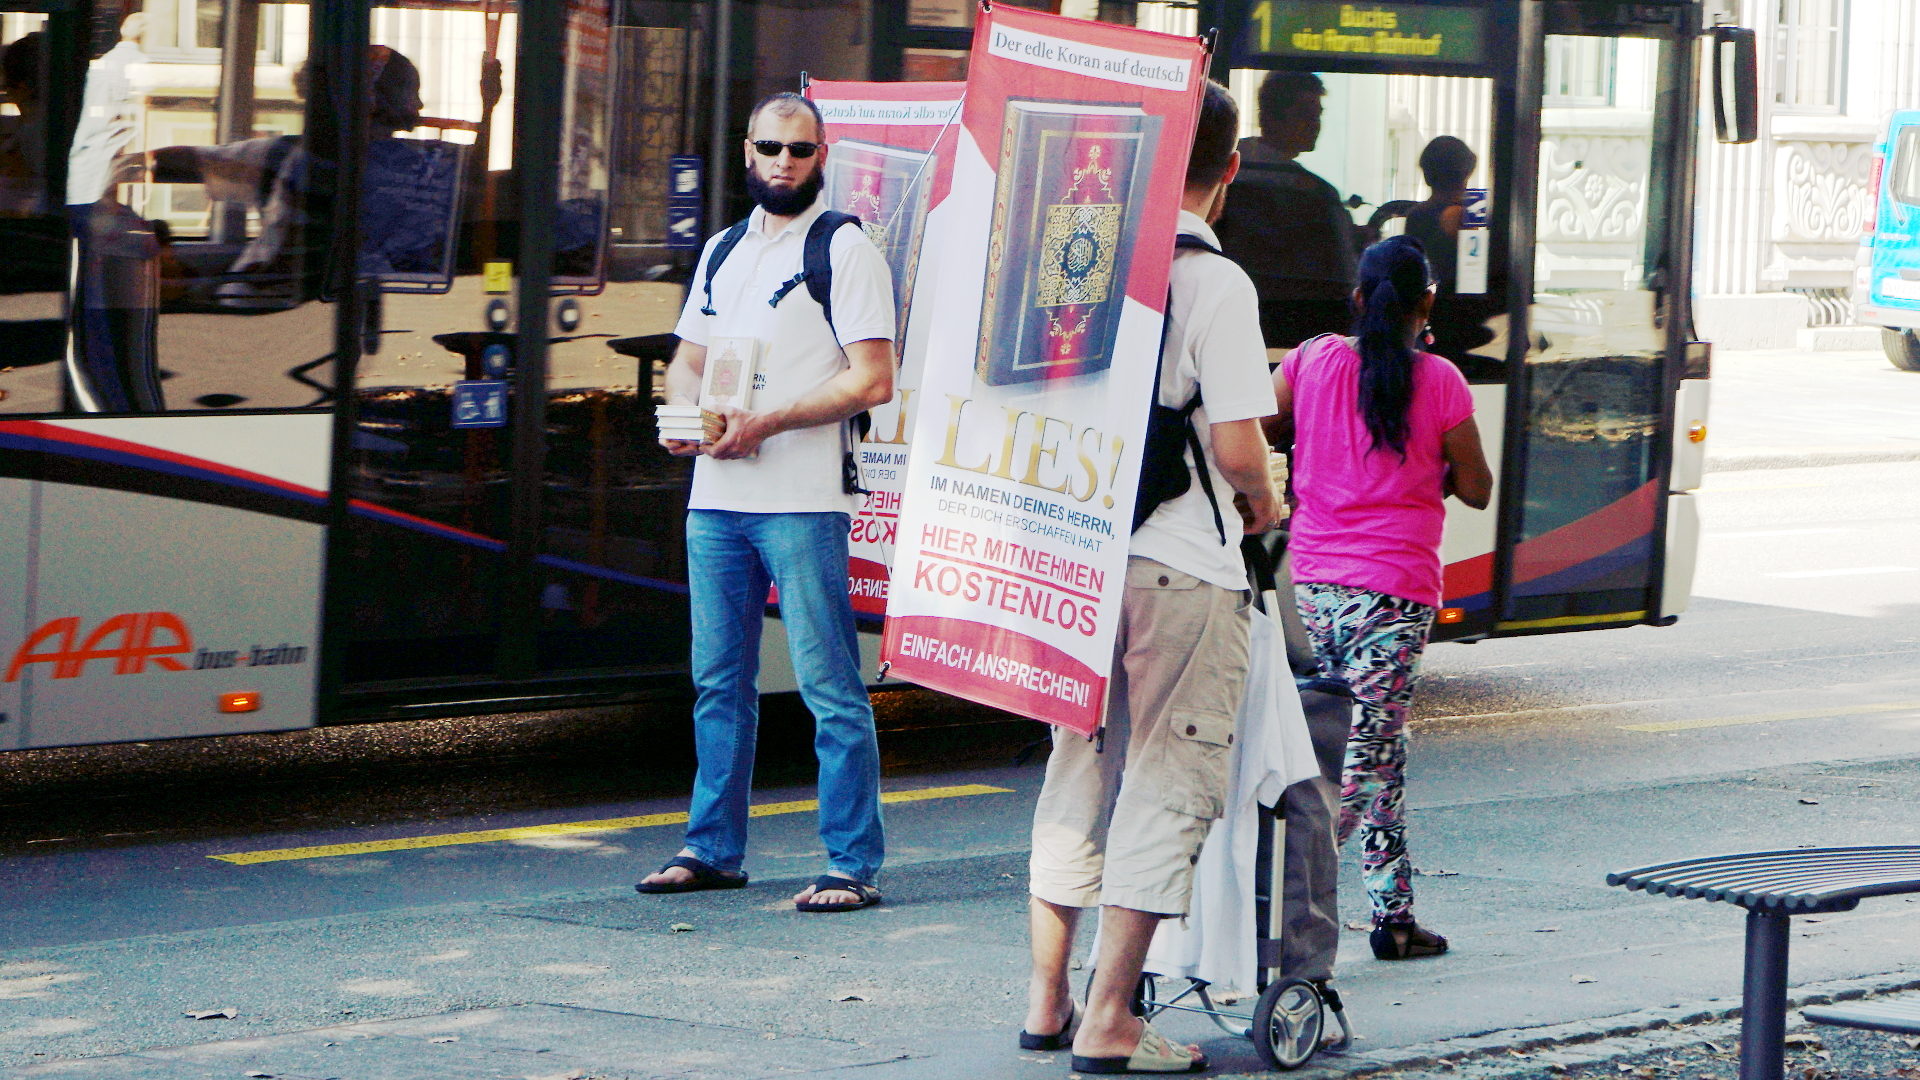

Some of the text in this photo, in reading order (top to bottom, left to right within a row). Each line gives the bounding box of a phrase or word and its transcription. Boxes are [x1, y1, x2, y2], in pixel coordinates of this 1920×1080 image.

[1252, 1, 1272, 51] 1
[1340, 4, 1397, 29] Buchs
[995, 32, 1184, 83] Der edle Koran auf deutsch
[934, 393, 1125, 510] LIES!
[930, 475, 1116, 540] IM NAMEN DEINES HERRN,
[938, 498, 1103, 553] DER DICH ERSCHAFFEN HAT
[921, 523, 1105, 593] HIER MITNEHMEN
[913, 559, 1098, 637] KOSTENLOS
[3, 611, 194, 683] AAR
[900, 632, 1090, 708] EINFACH ANSPRECHEN!
